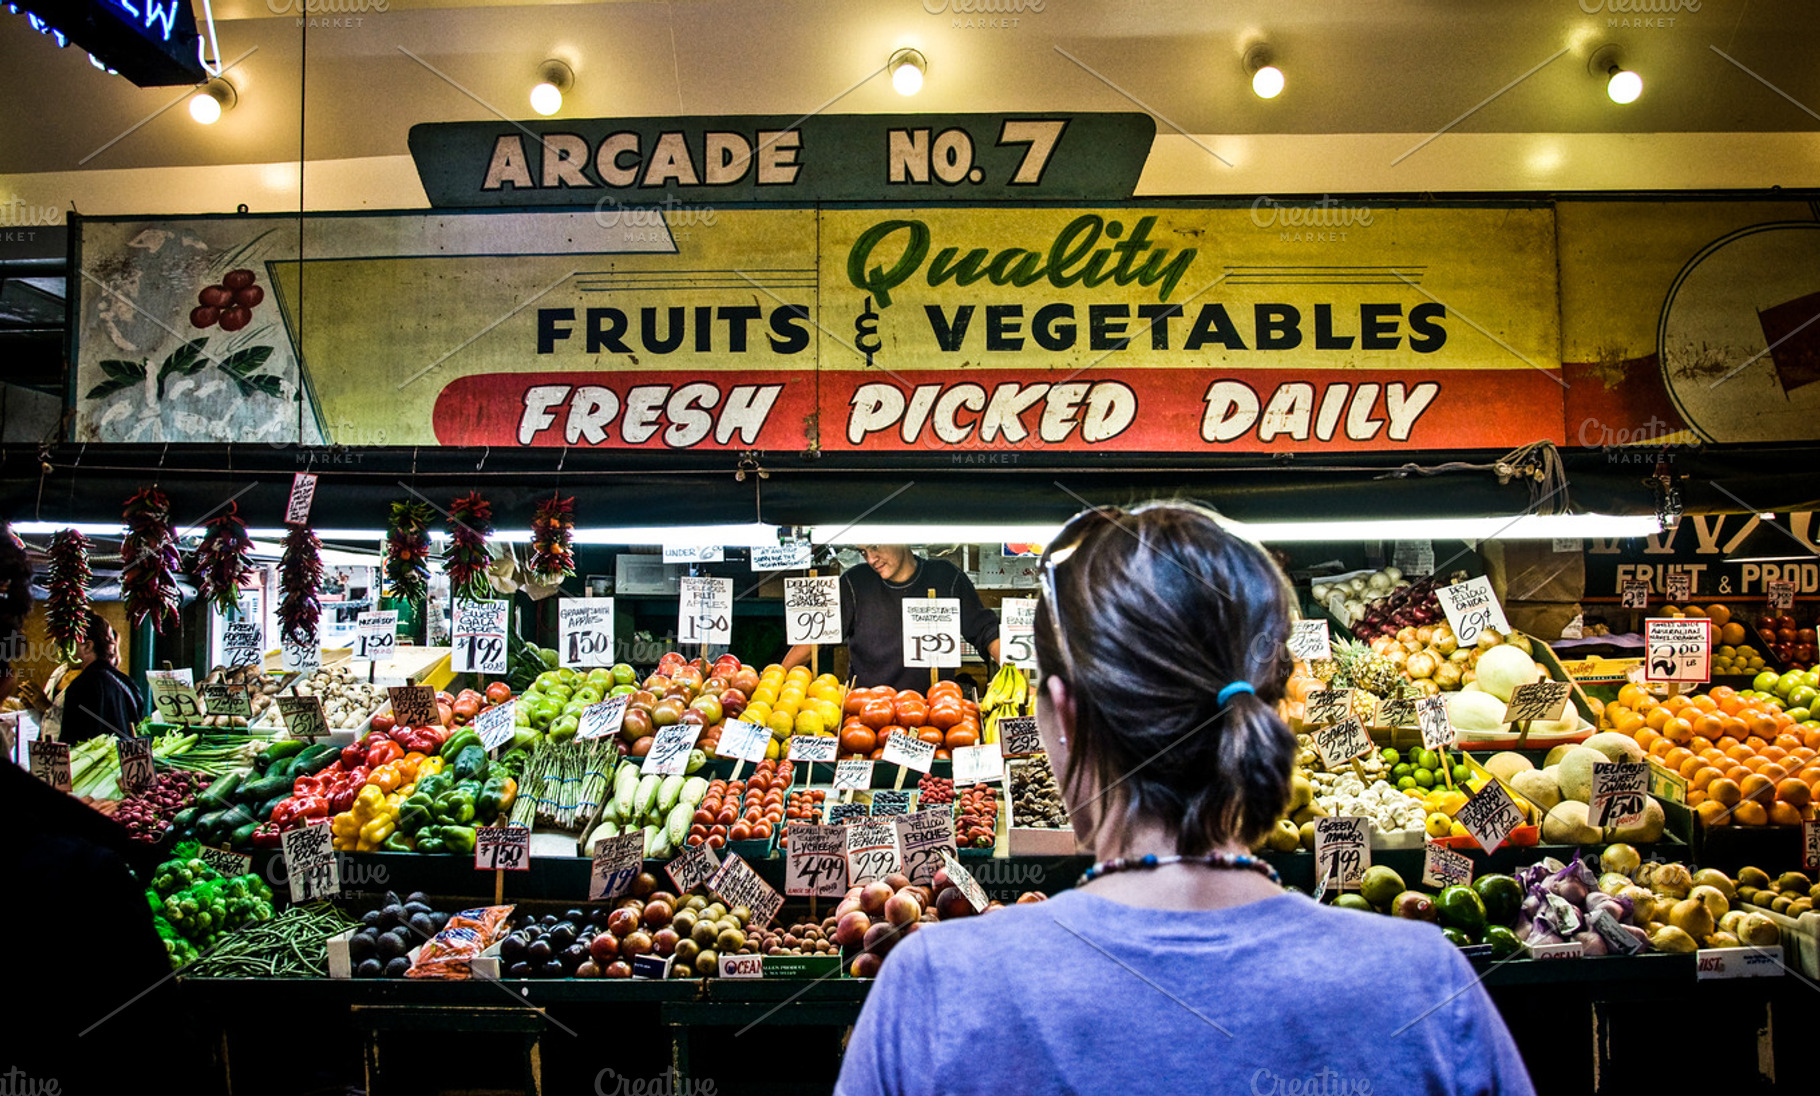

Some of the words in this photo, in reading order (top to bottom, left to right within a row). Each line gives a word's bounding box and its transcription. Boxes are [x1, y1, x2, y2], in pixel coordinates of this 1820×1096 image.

[480, 128, 804, 192] ARCADE
[886, 127, 986, 186] NO.
[996, 118, 1072, 187] 7
[847, 214, 1198, 309] Quality
[537, 304, 811, 354] FRUITS
[855, 297, 882, 366] &
[924, 302, 1448, 354] VEGETABLES
[516, 382, 787, 449] FRESH
[846, 381, 1138, 446] PICKED
[1199, 381, 1442, 444] DAILY
[665, 548, 696, 557] UNDER
[1718, 576, 1732, 593] &
[904, 827, 952, 843] PEACHES
[909, 817, 945, 831] YELLOW
